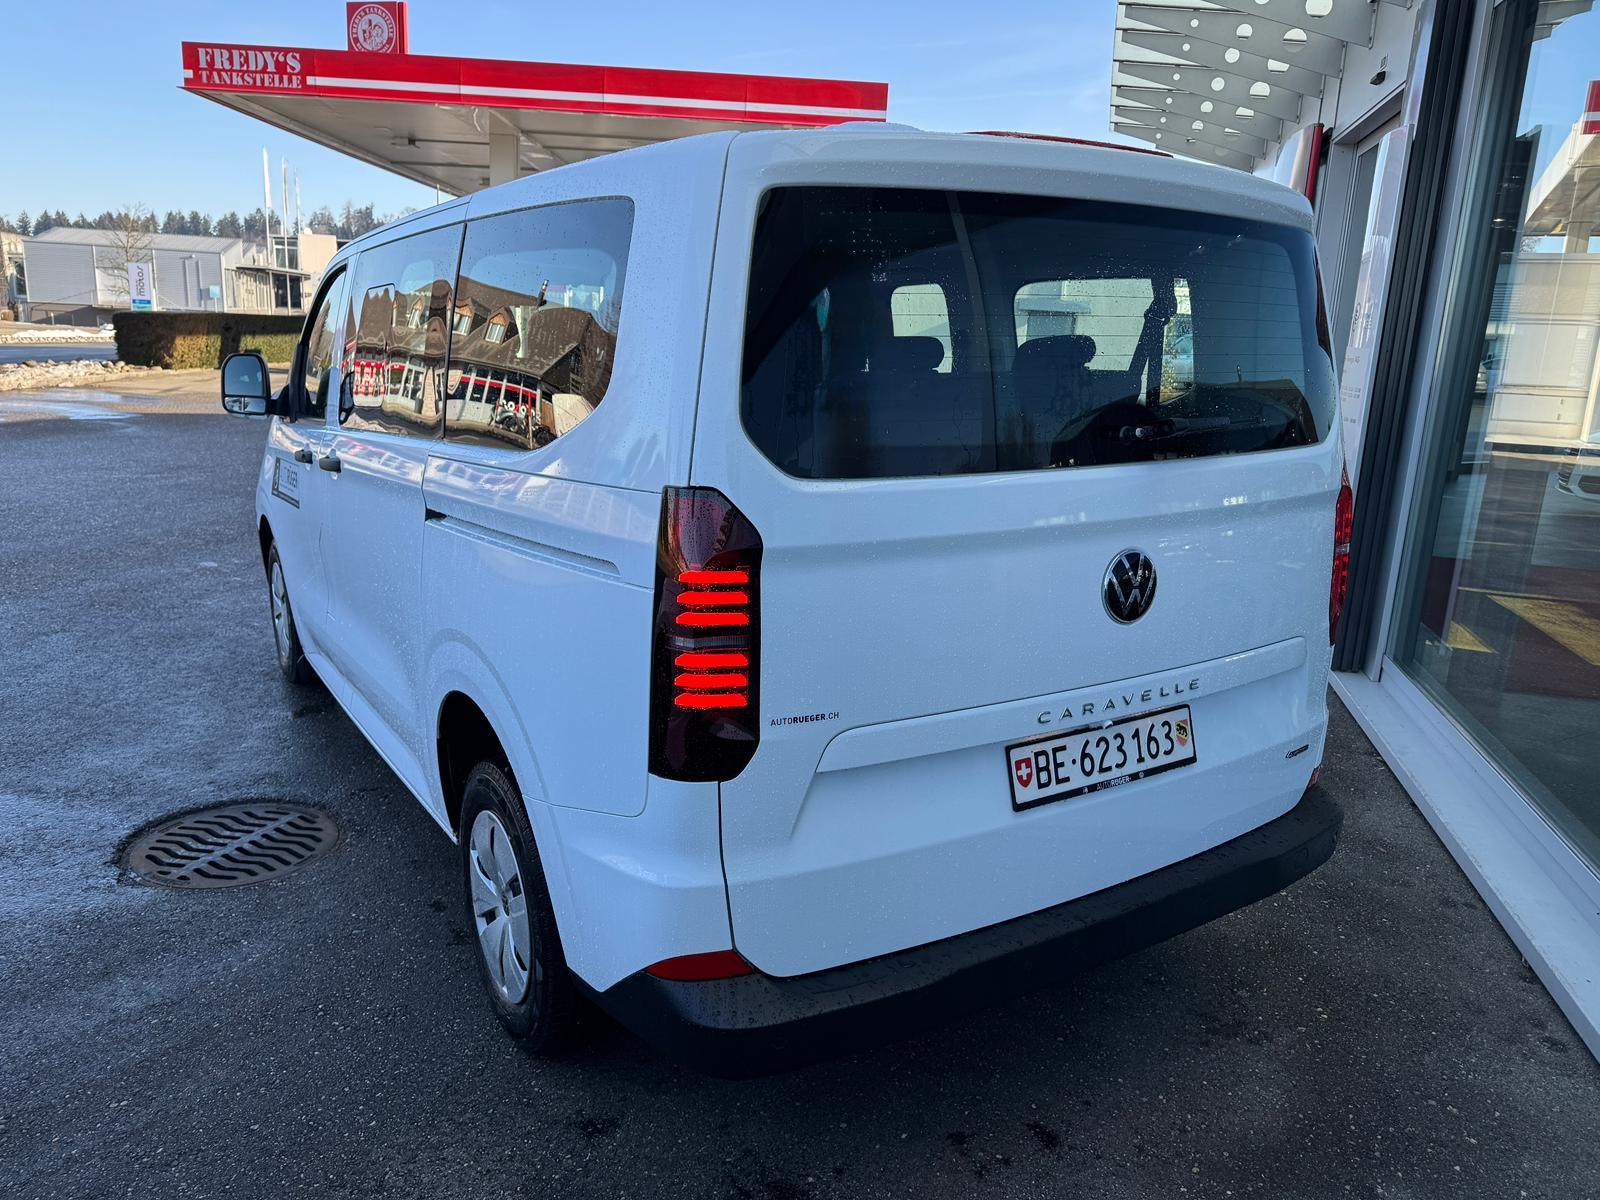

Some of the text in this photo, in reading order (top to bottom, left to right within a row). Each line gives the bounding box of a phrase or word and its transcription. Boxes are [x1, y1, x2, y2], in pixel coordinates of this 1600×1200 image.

[199, 70, 302, 89] TANKSTELLE
[1037, 678, 1200, 724] CARAVELLE
[770, 712, 840, 727] AUTORUEGER.CH
